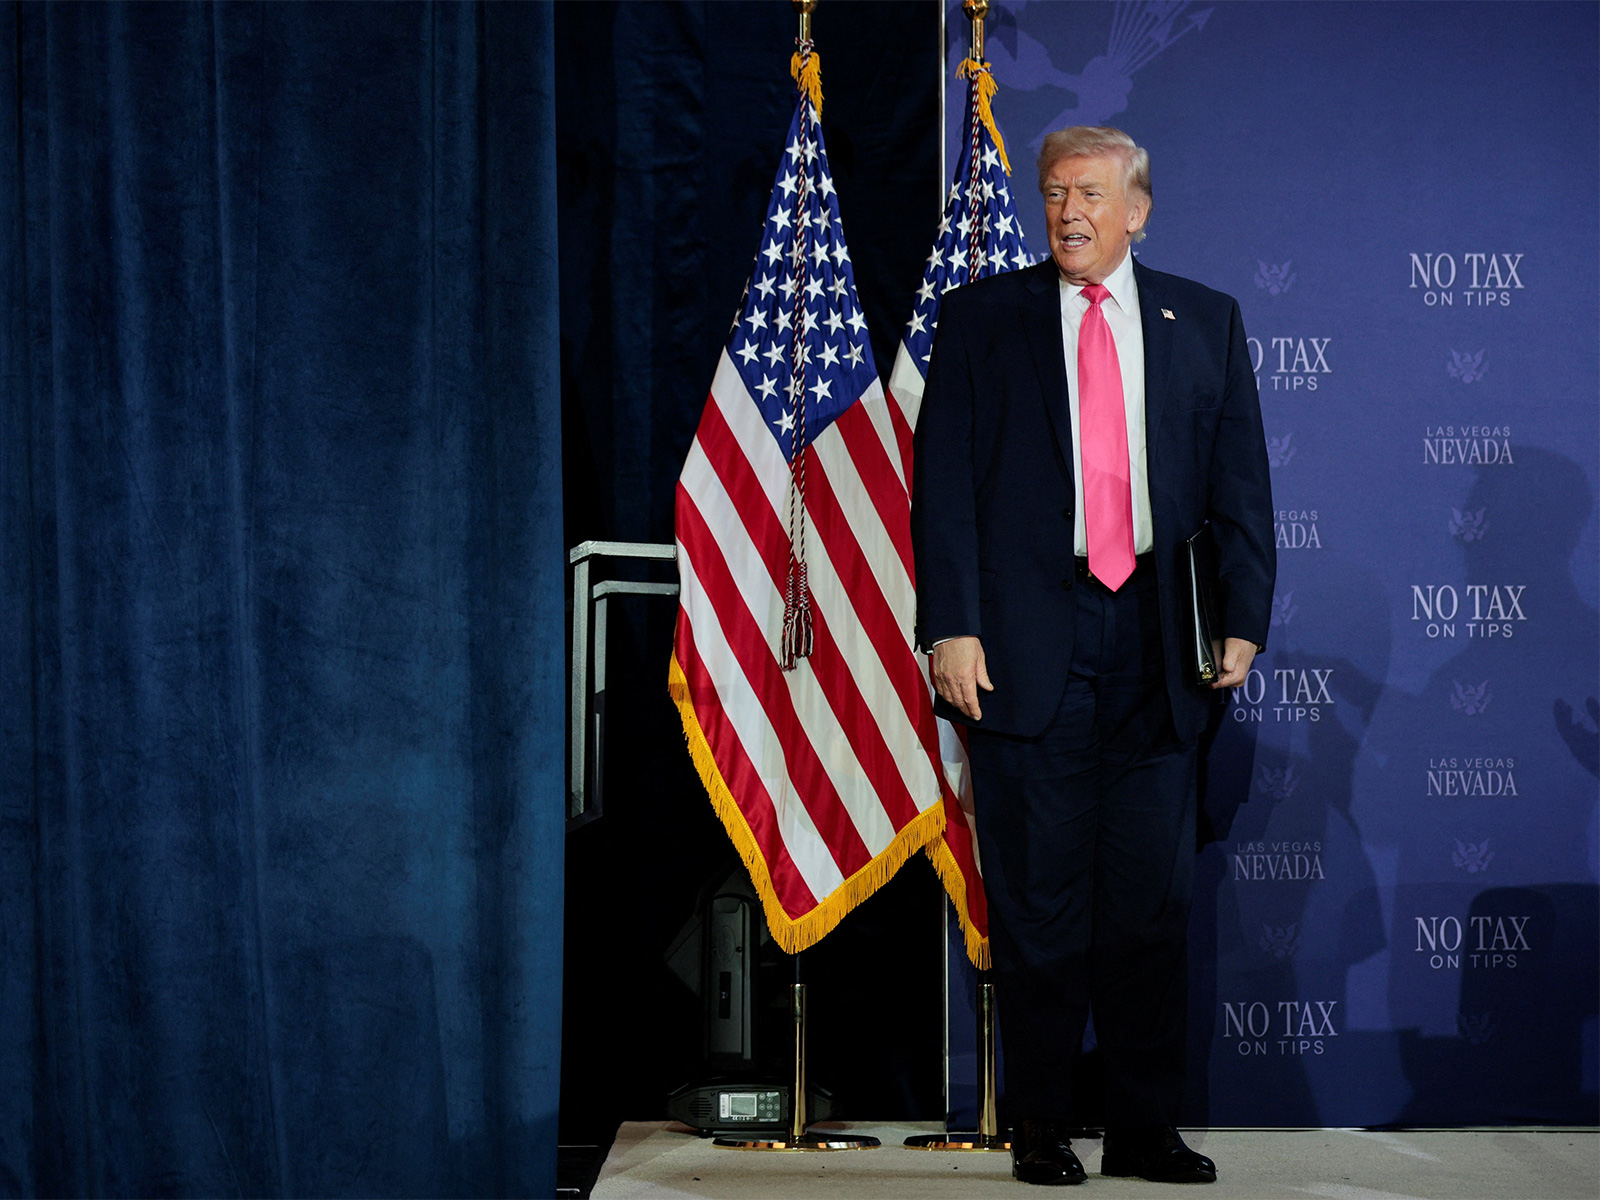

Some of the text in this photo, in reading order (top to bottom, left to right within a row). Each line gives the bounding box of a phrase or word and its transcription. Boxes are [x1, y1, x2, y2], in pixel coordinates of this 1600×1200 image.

[1409, 252, 1525, 289] NO TAX
[1423, 290, 1511, 307] ON TIPS
[1246, 336, 1333, 373] O TAX
[1270, 375, 1318, 391] TIPS
[1426, 425, 1511, 438] LAS VEGAS
[1423, 438, 1514, 465] NEVADA
[1275, 522, 1322, 549] ADA
[1410, 584, 1528, 621] NO TAX
[1425, 623, 1513, 639] ON TIPS
[1273, 668, 1335, 705] TAX
[1233, 707, 1321, 723] ON TIPS
[1429, 757, 1515, 769] LAS VEGAS
[1426, 770, 1518, 797] NEVADA
[1237, 841, 1322, 853] LAS VEGAS
[1233, 854, 1326, 881] NEVADA
[1414, 915, 1532, 952] NO TAX
[1429, 953, 1517, 970] ON TIPS
[1222, 1000, 1339, 1038] NO TAX
[1237, 1039, 1325, 1056] ON TIPS
